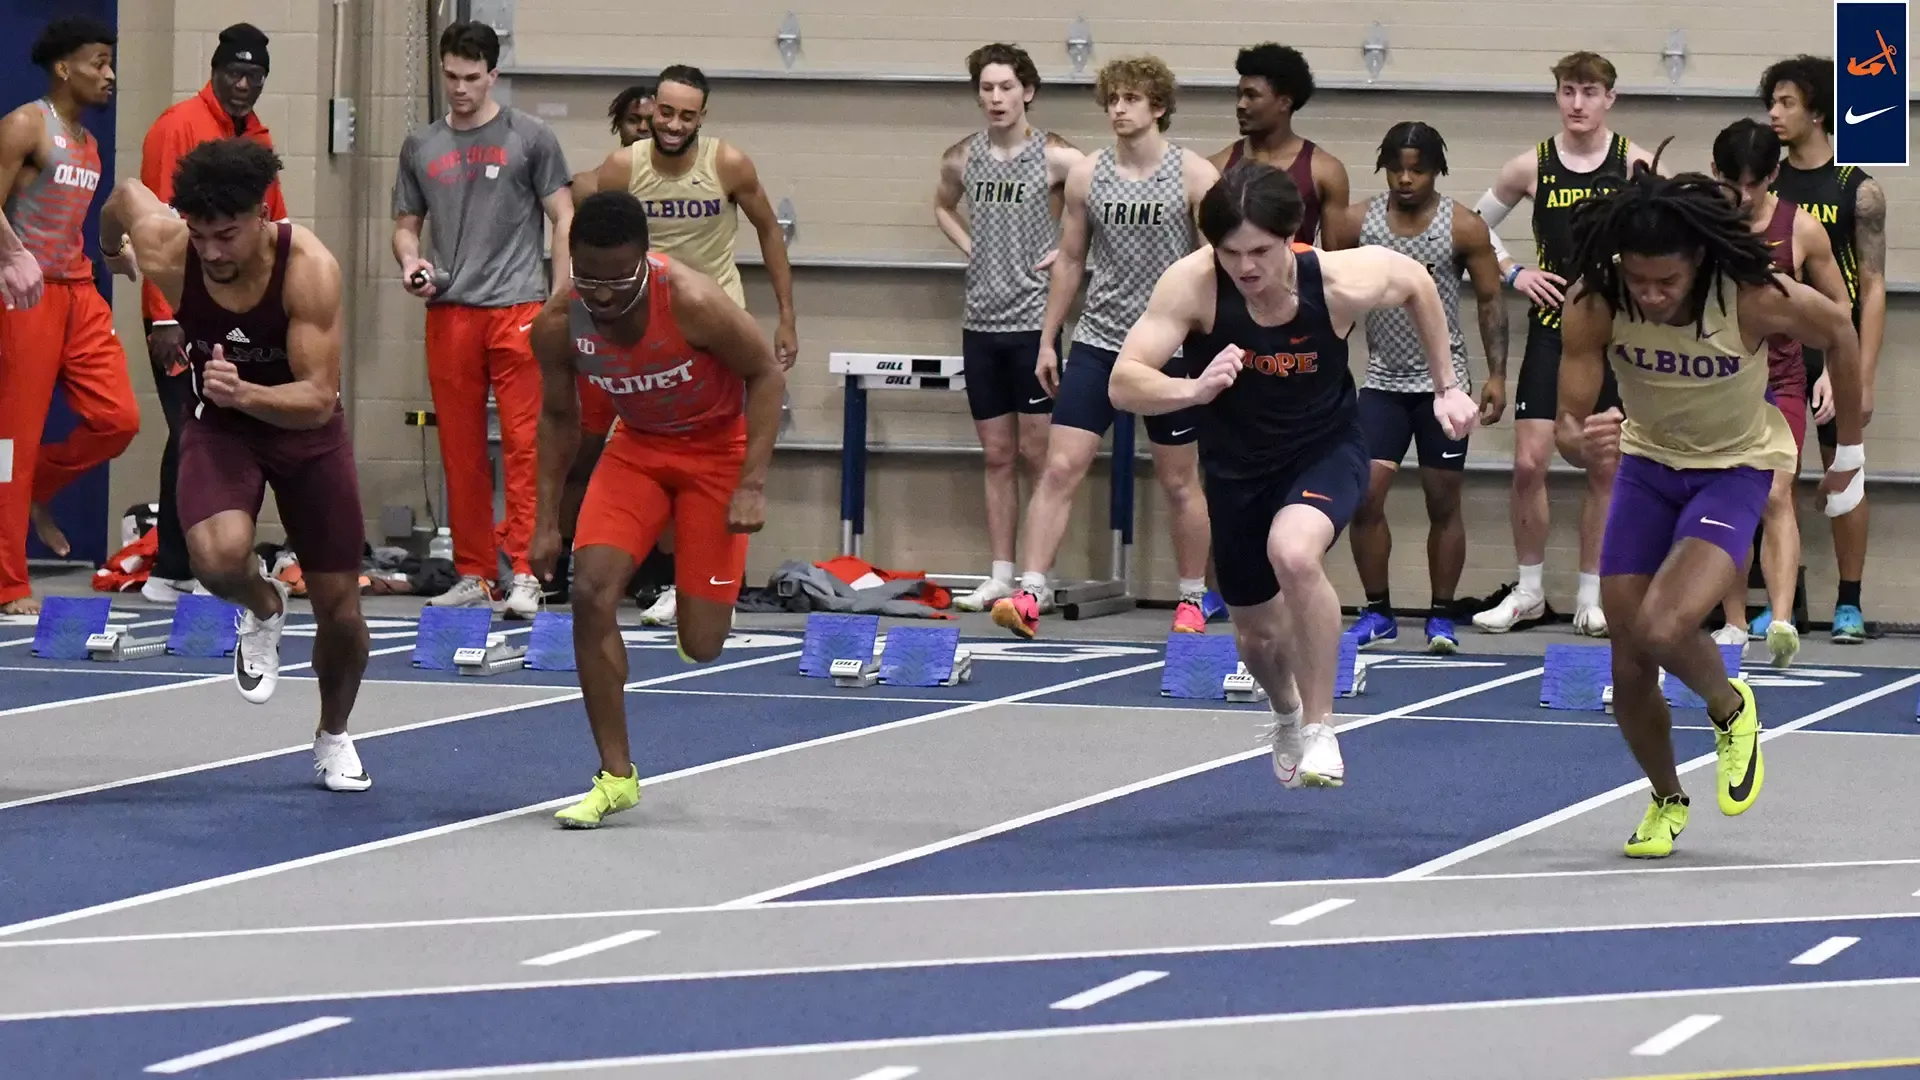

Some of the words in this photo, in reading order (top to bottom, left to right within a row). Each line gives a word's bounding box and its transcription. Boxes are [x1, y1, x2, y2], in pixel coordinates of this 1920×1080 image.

[974, 181, 1027, 204] TRINE
[644, 199, 721, 218] LBION
[1103, 202, 1164, 226] TRINE
[876, 361, 903, 371] GILL
[885, 375, 912, 385] GILL
